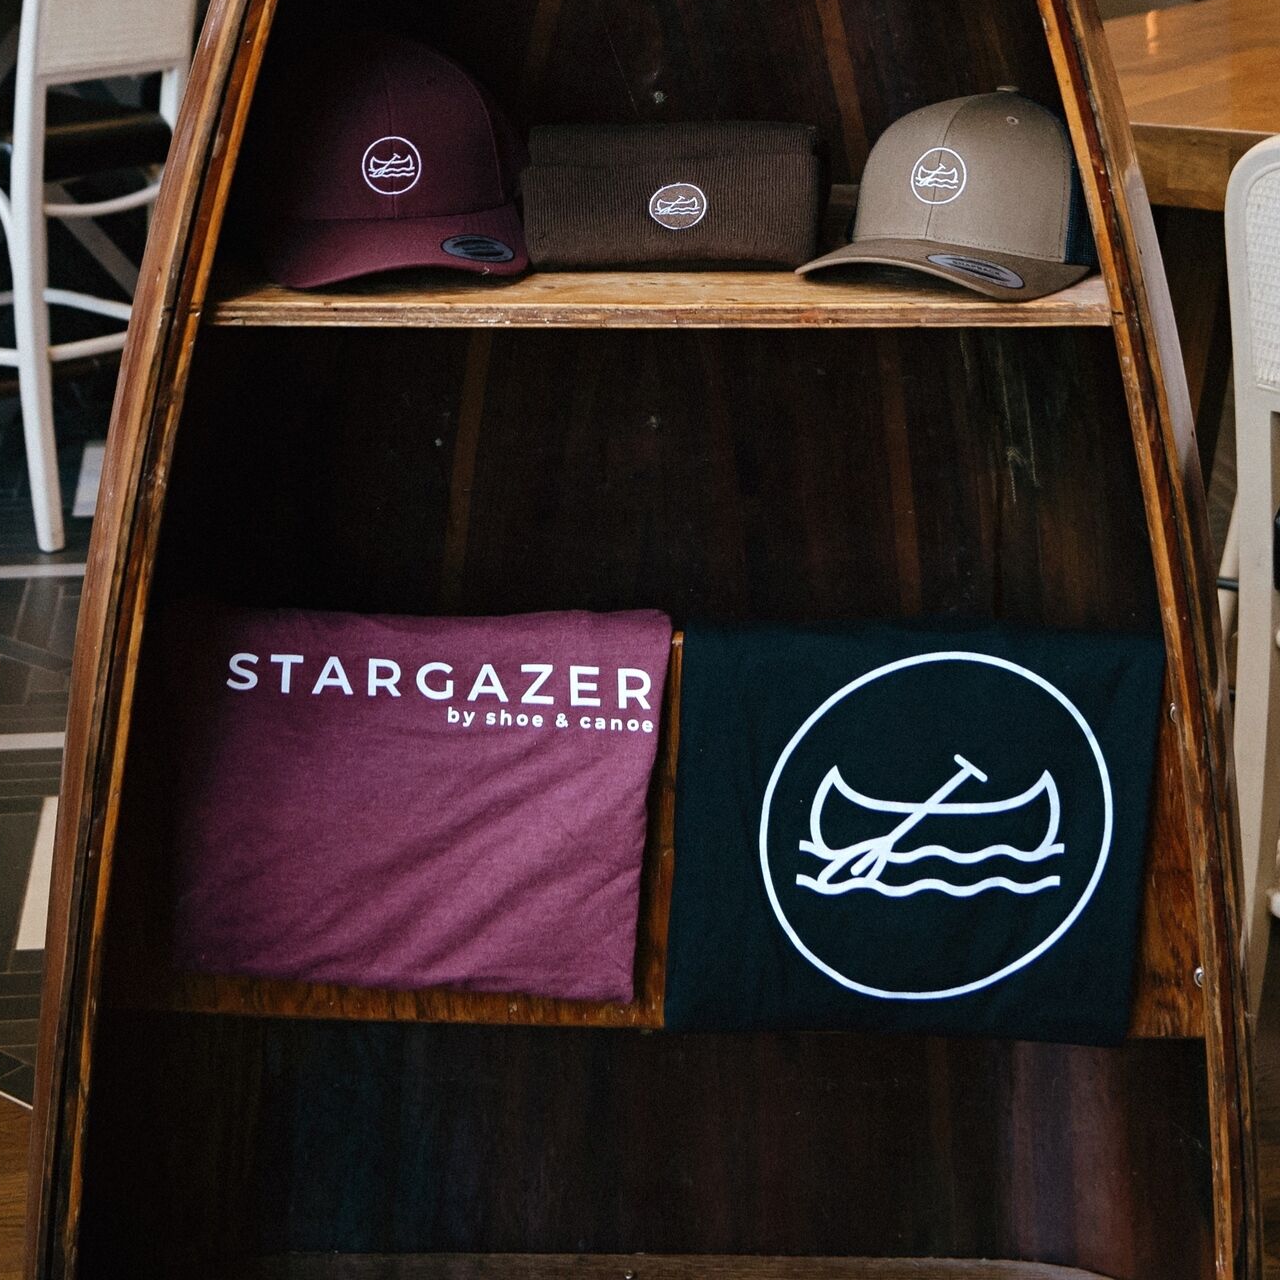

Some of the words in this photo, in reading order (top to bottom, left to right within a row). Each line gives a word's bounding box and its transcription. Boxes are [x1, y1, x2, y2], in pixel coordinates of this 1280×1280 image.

[226, 652, 653, 711] STARGAZER
[447, 706, 476, 727] by
[486, 709, 544, 729] shoe
[555, 713, 570, 729] &
[580, 715, 654, 733] canoe
